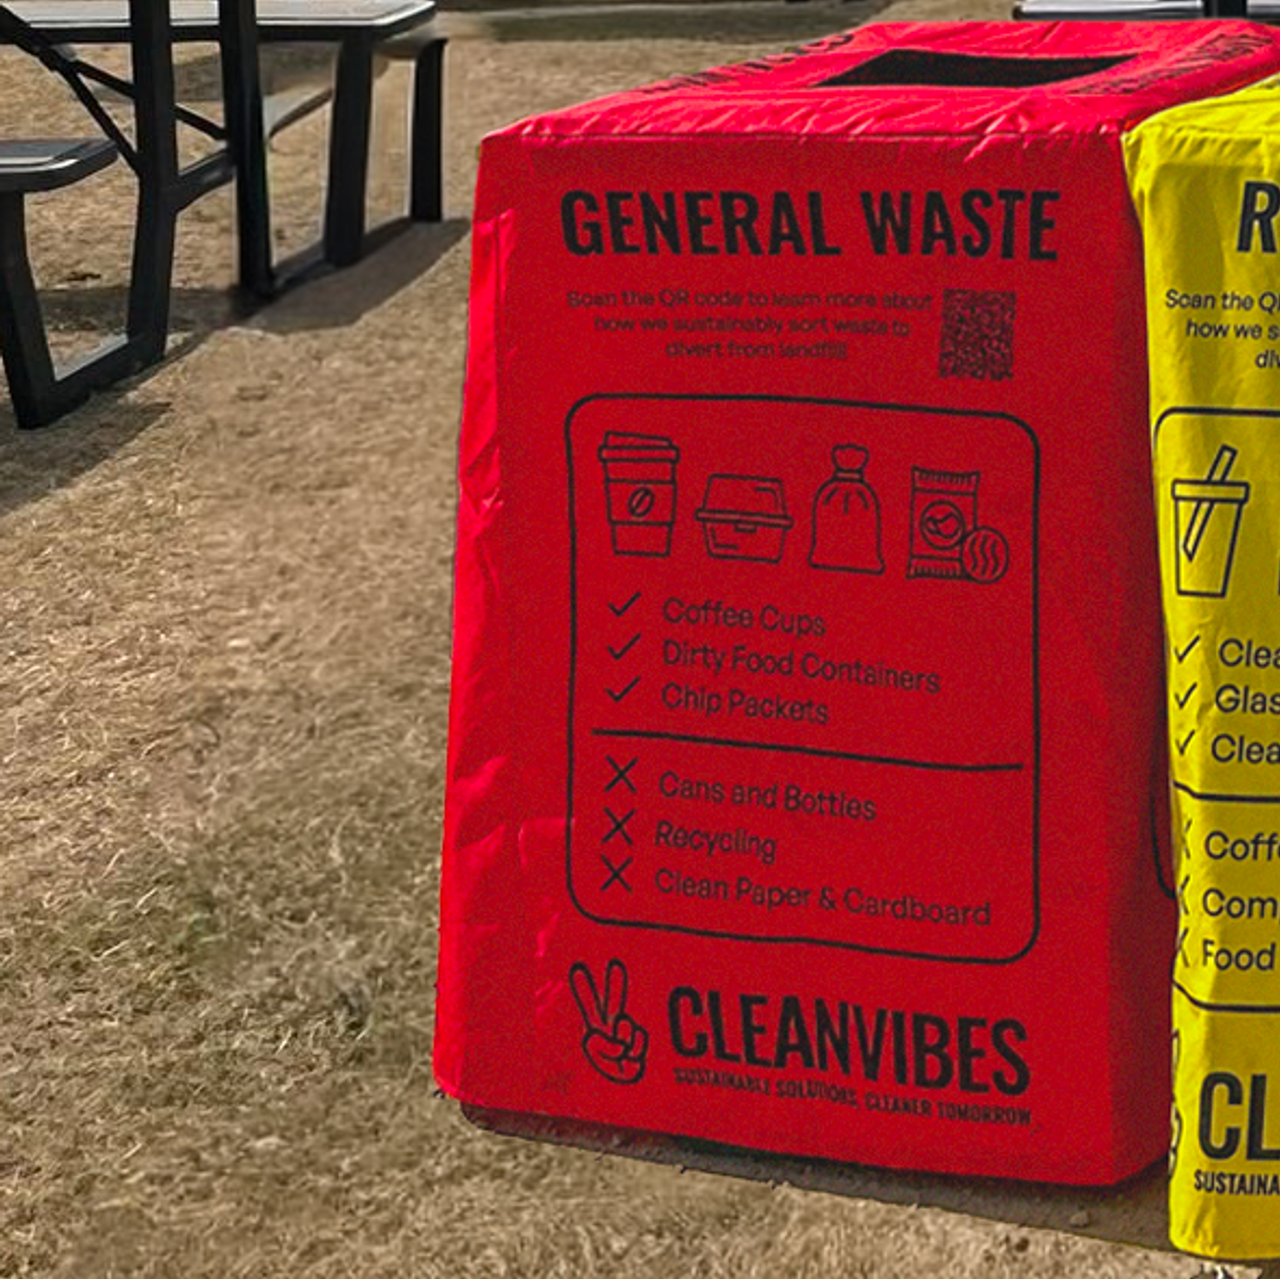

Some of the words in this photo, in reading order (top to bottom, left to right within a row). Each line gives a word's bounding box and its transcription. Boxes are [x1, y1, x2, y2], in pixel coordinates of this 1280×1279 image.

[560, 189, 842, 257] GENERAL
[860, 189, 1061, 261] WASTE
[659, 289, 690, 309] QR
[1165, 289, 1217, 310] Scan
[1221, 291, 1255, 312] the
[1186, 319, 1230, 338] how
[1233, 324, 1263, 339] we
[662, 598, 753, 629] Coffee
[760, 605, 826, 637] Cups
[663, 639, 726, 674] Dirty
[733, 646, 794, 676] Food
[801, 653, 940, 694] Containers
[661, 683, 722, 716] Chip
[728, 689, 829, 724] Packets
[659, 771, 725, 802] Cans
[732, 782, 777, 809] and
[784, 785, 876, 820] Bottles
[655, 821, 776, 864] Recycling
[655, 868, 728, 901] Clean
[736, 877, 810, 912] Paper
[819, 887, 836, 910] &
[843, 887, 991, 925] Cardboard
[1202, 939, 1275, 972] Food
[667, 985, 1031, 1096] CLEANVIBES
